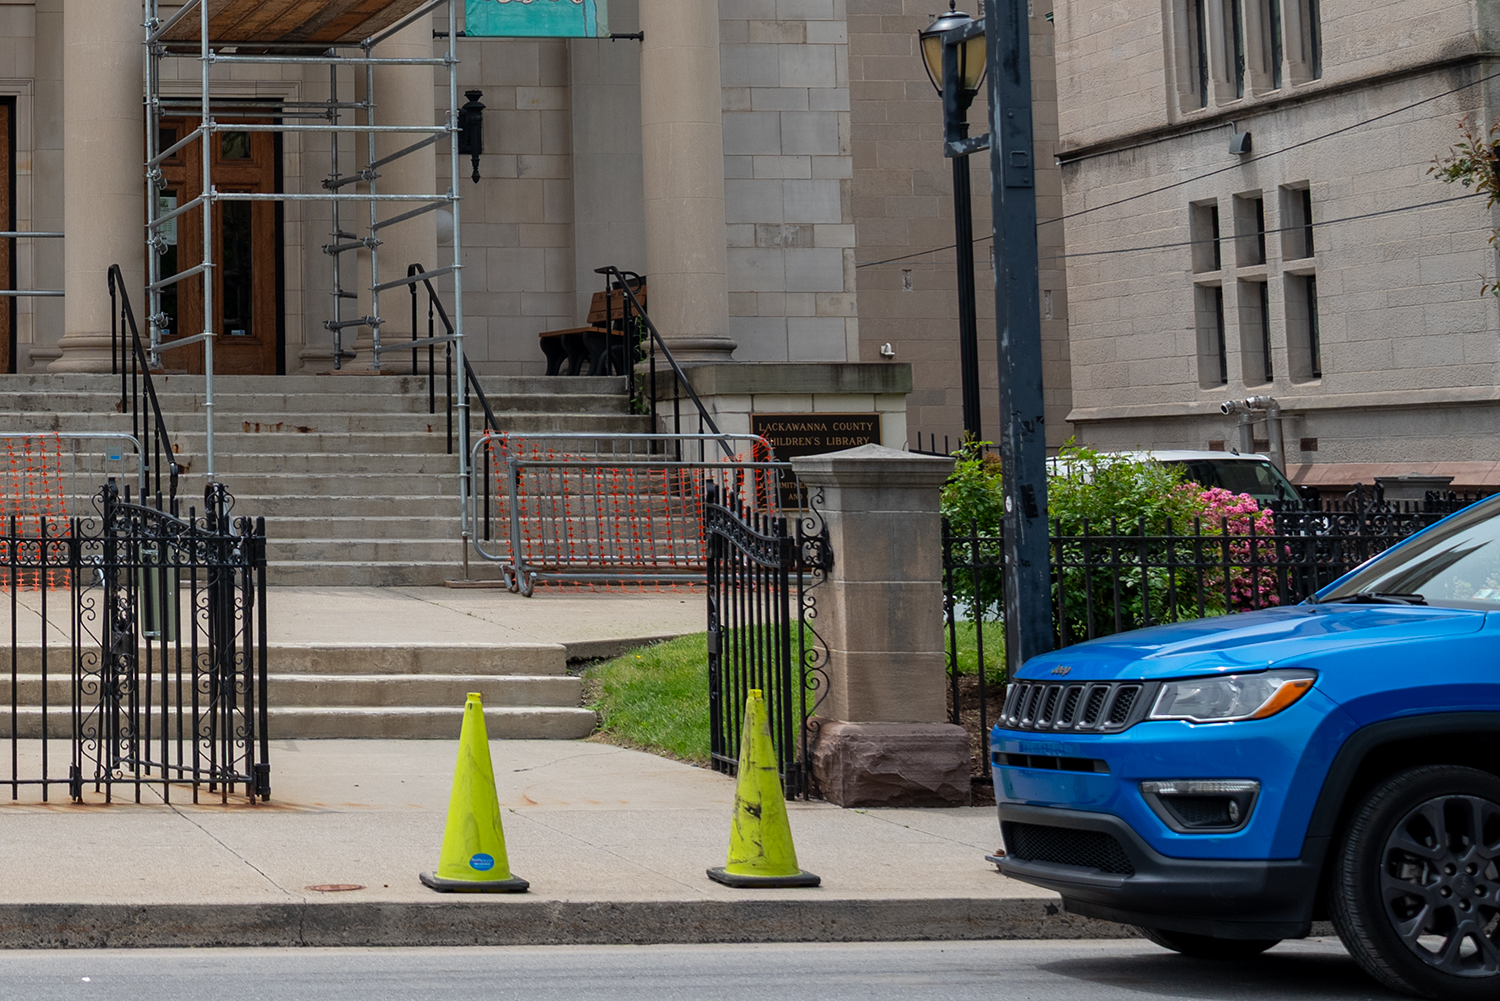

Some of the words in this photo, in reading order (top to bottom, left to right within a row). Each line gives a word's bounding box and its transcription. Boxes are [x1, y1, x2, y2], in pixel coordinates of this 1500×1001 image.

[758, 422, 828, 431] LACKAWANNA
[832, 422, 873, 431] COUNTY
[769, 436, 821, 446] HILDREN'S
[826, 436, 870, 446] LIBRARY
